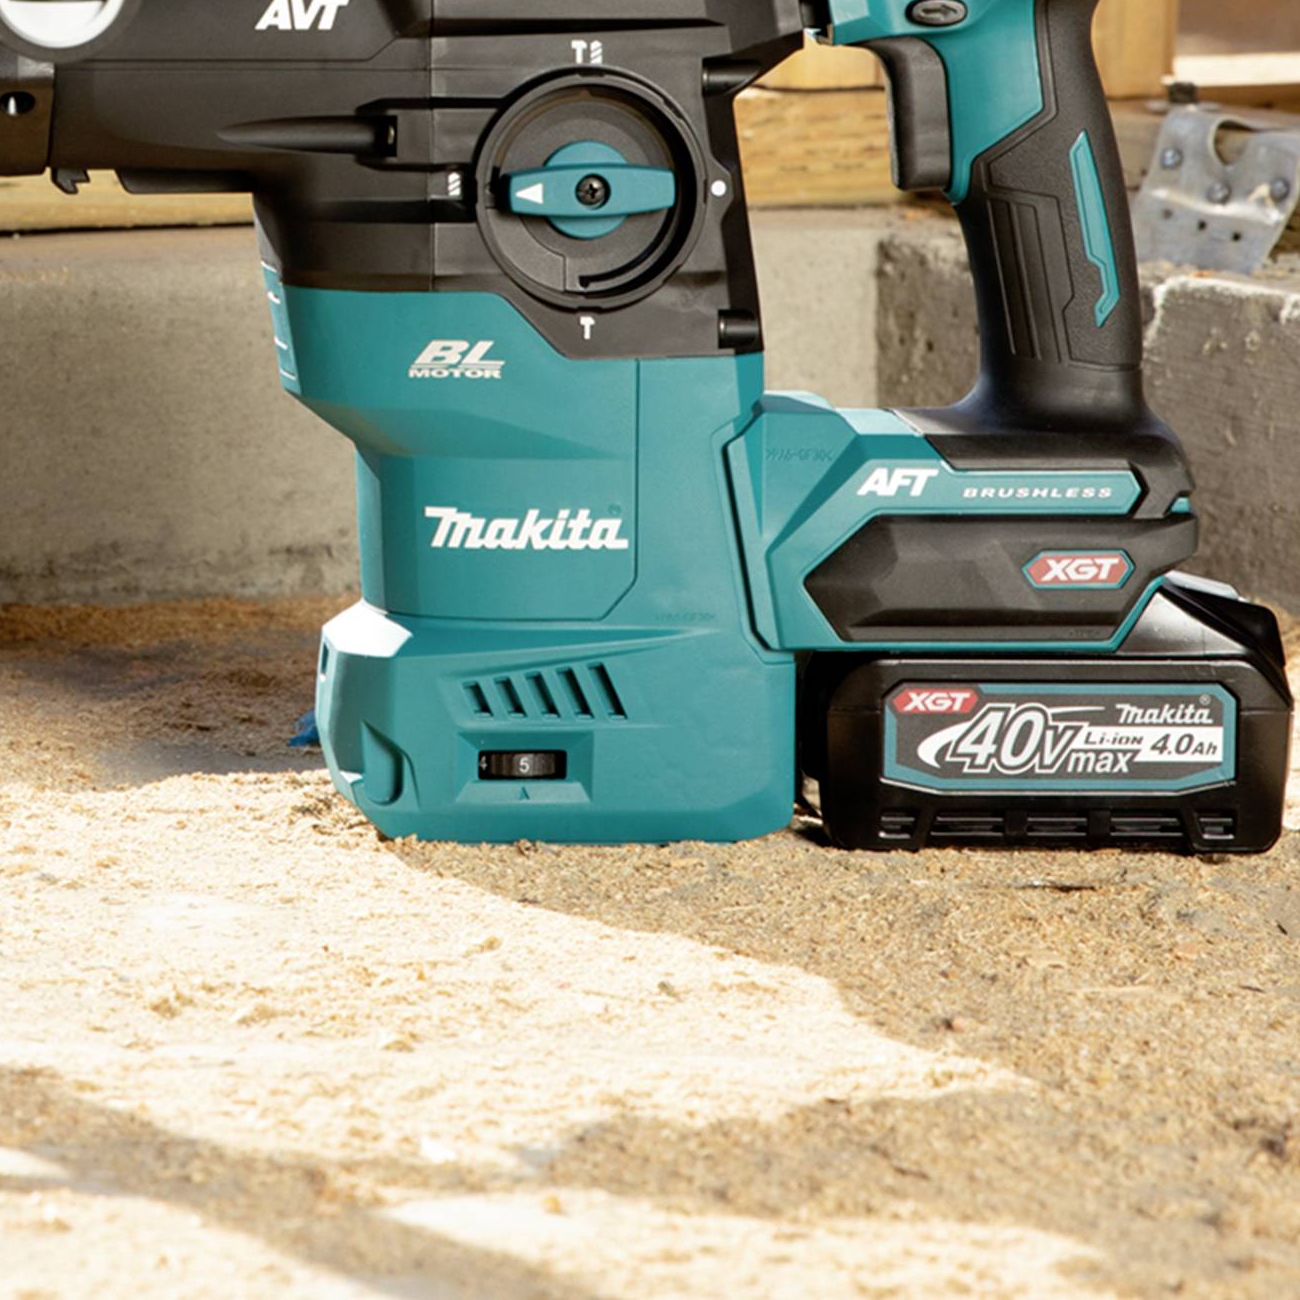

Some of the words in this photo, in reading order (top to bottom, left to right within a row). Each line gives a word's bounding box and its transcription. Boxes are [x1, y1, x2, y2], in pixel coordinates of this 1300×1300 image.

[411, 339, 506, 368] BL
[408, 368, 502, 379] MOTOR
[856, 467, 939, 496] AFT
[962, 487, 1112, 499] BRUSHLESS
[1040, 557, 1120, 582] XGT
[902, 691, 971, 712] XGT
[518, 756, 530, 773] 5
[1066, 751, 1133, 774] max
